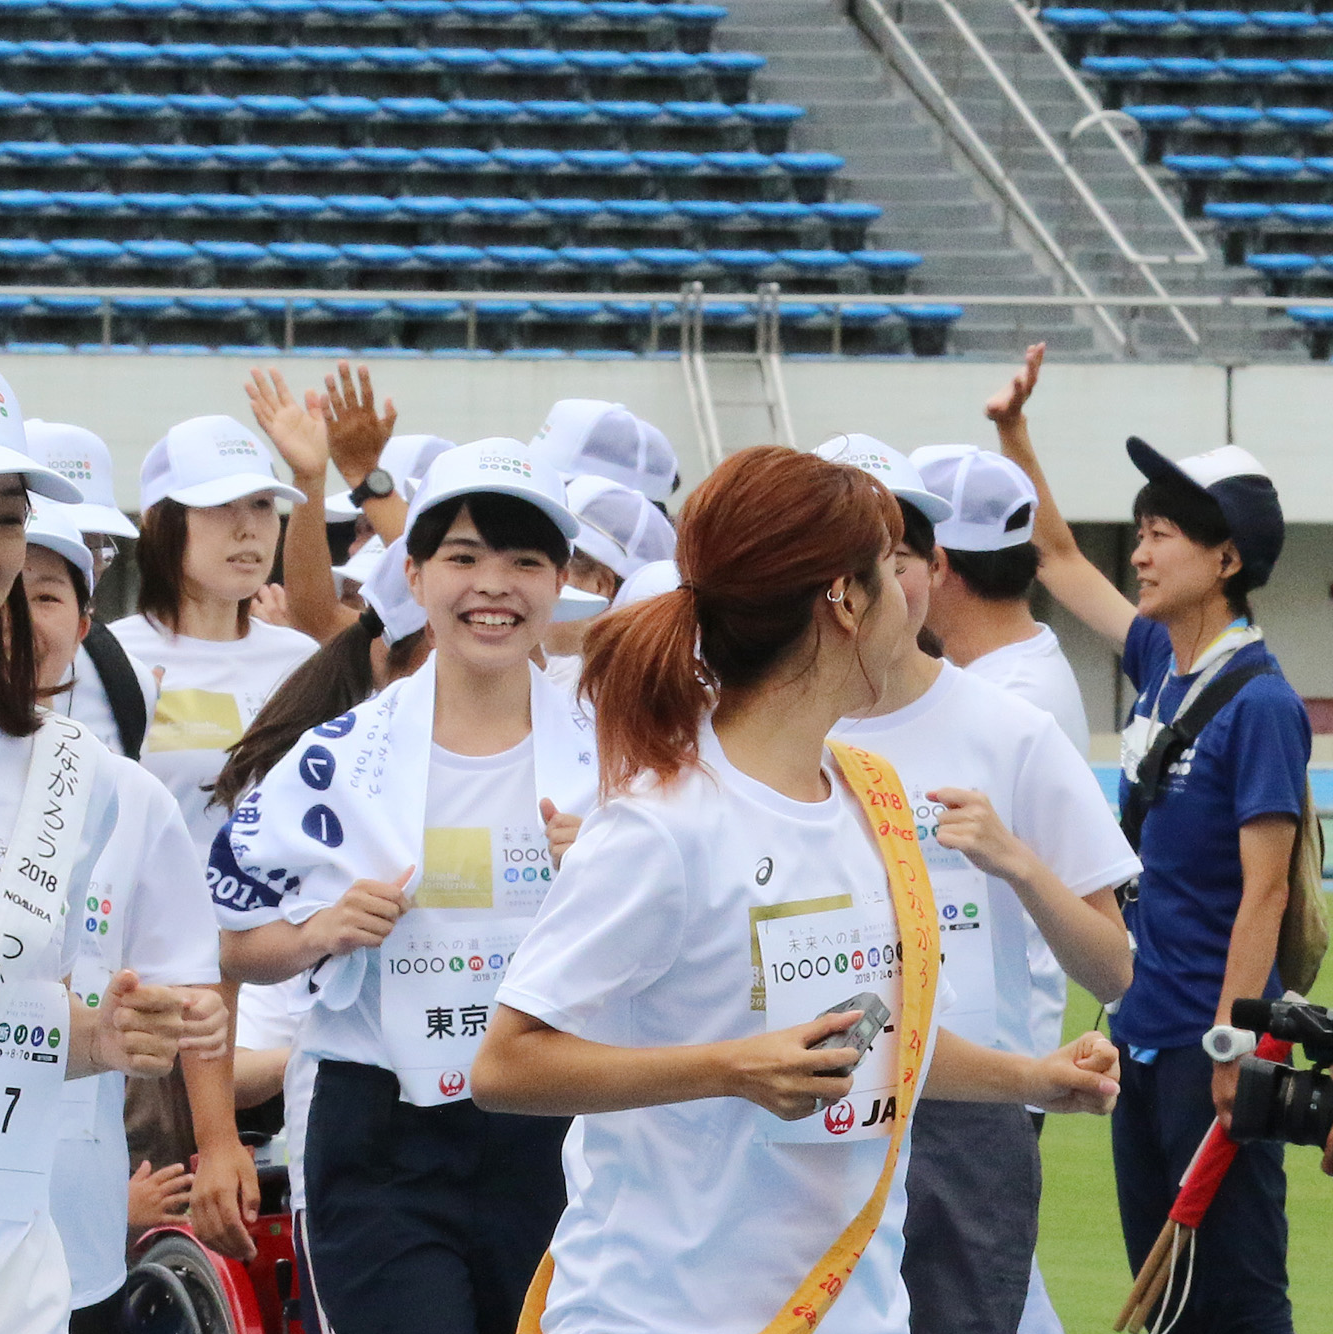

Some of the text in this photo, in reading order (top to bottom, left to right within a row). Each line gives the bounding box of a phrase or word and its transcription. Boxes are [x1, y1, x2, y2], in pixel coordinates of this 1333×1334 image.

[36, 715, 82, 860] つながろう
[18, 858, 58, 893] 2018
[3, 889, 52, 924] NOMURA
[789, 929, 861, 953] 未来への道
[426, 1004, 489, 1039] 東京
[1, 1087, 21, 1133] 7
